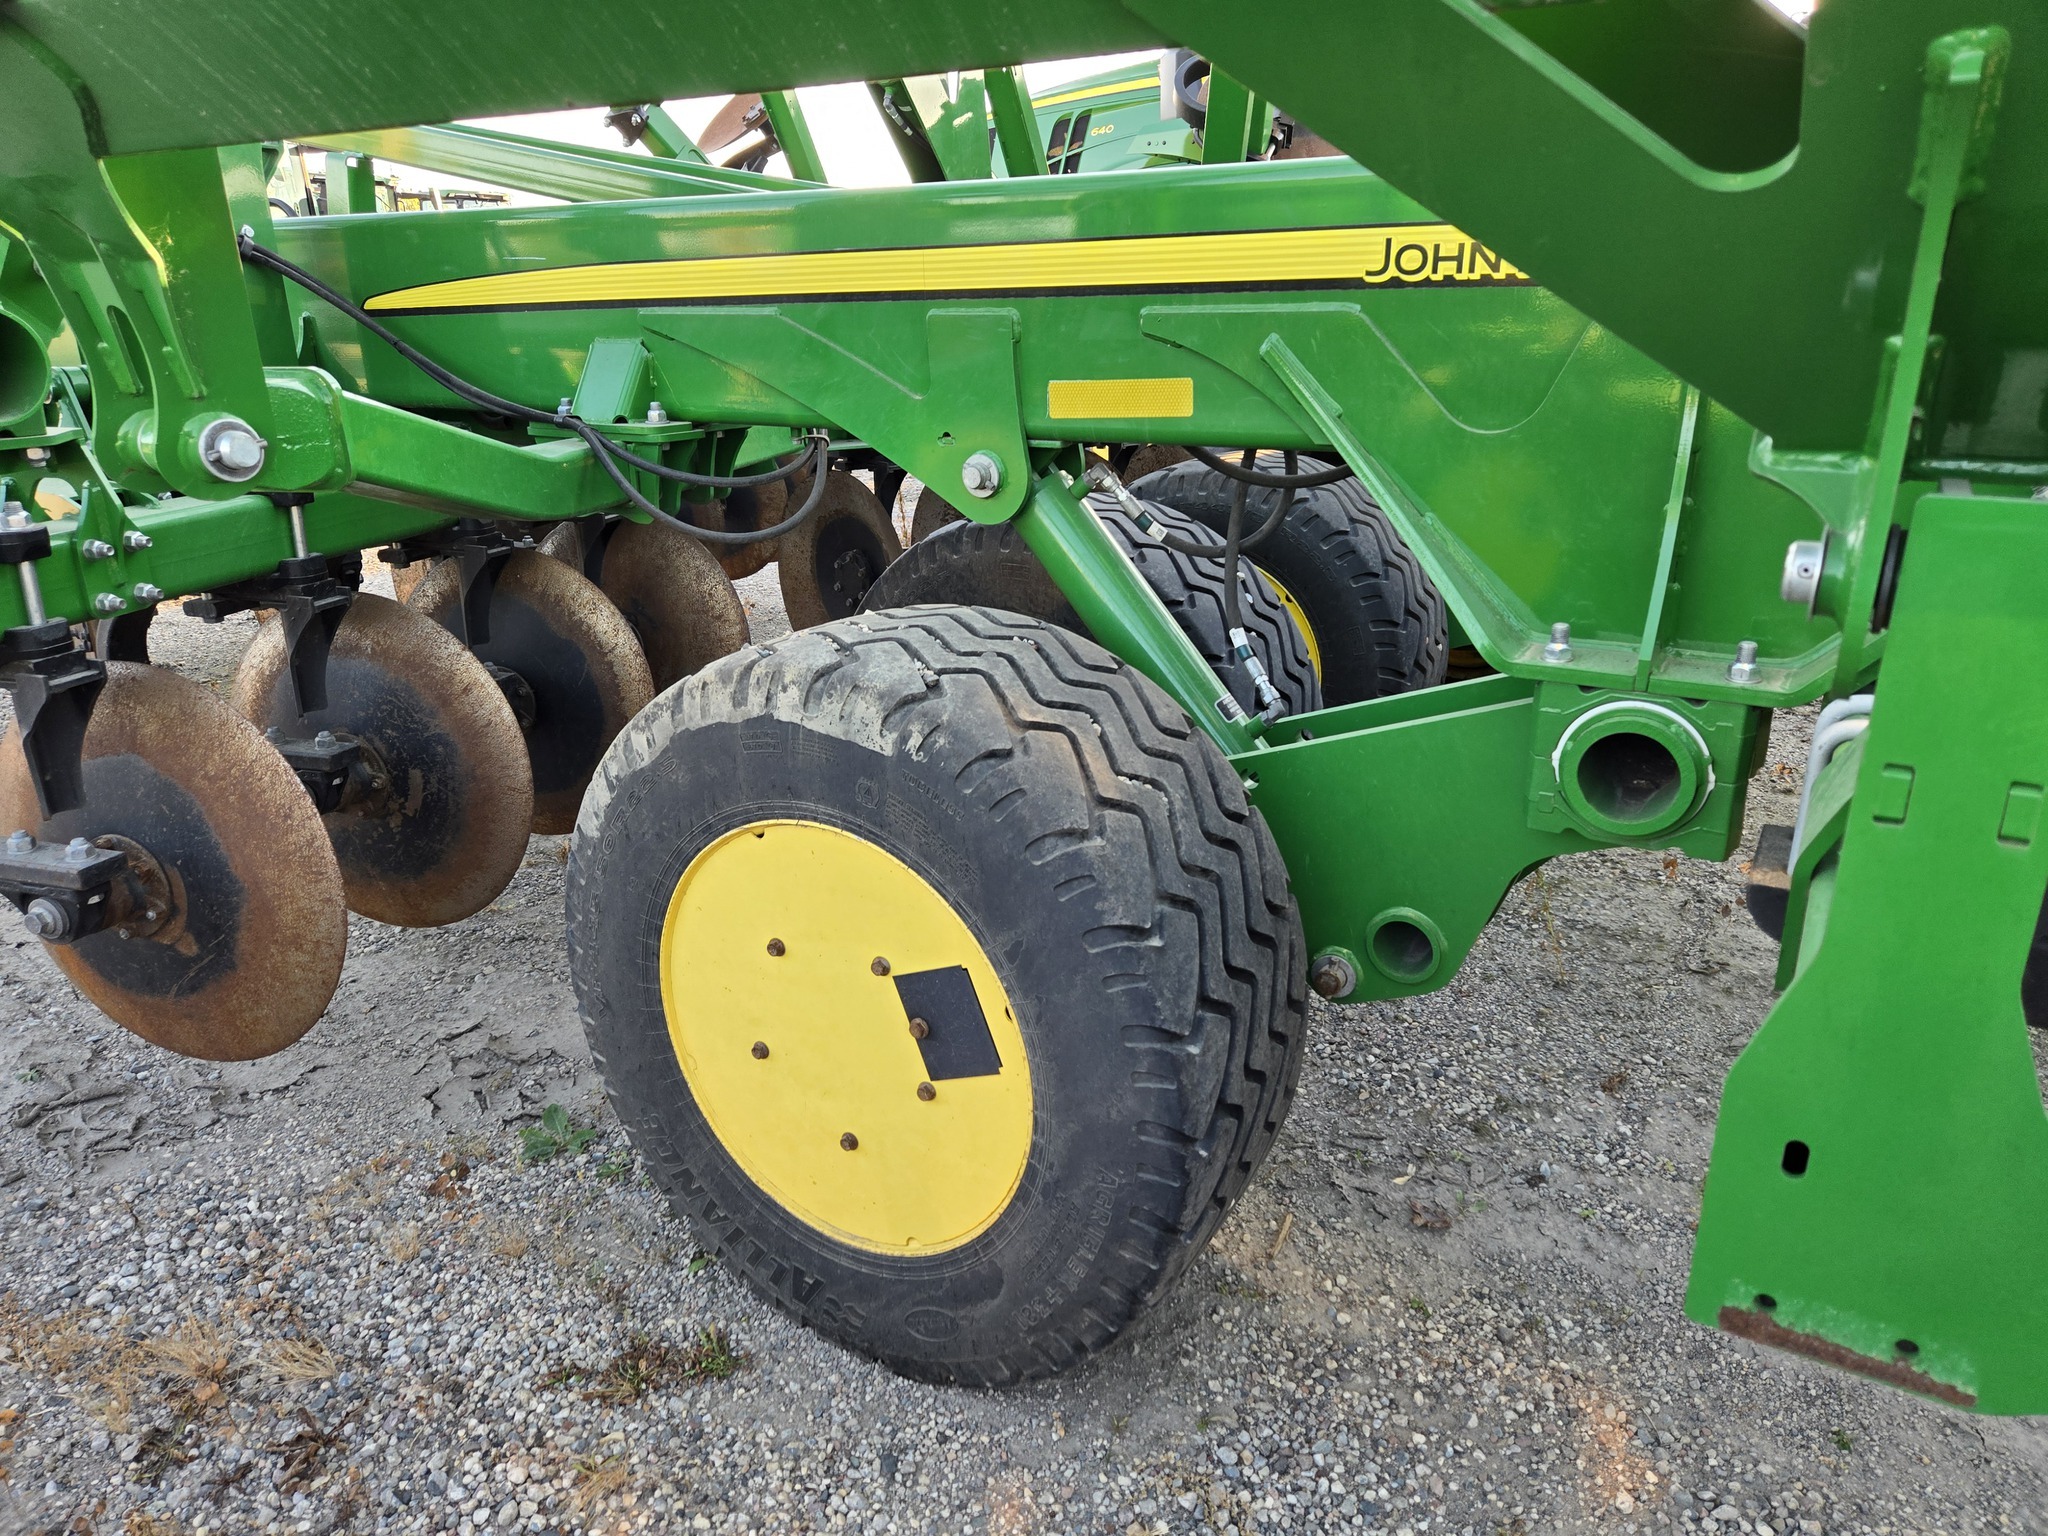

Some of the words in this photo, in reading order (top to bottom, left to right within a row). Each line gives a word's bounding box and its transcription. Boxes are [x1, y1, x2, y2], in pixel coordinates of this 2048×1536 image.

[1090, 124, 1115, 137] 640
[1364, 237, 1502, 277] JOHN
[901, 768, 966, 823] TUBELESS
[639, 1113, 826, 1306] ALLIANCE
